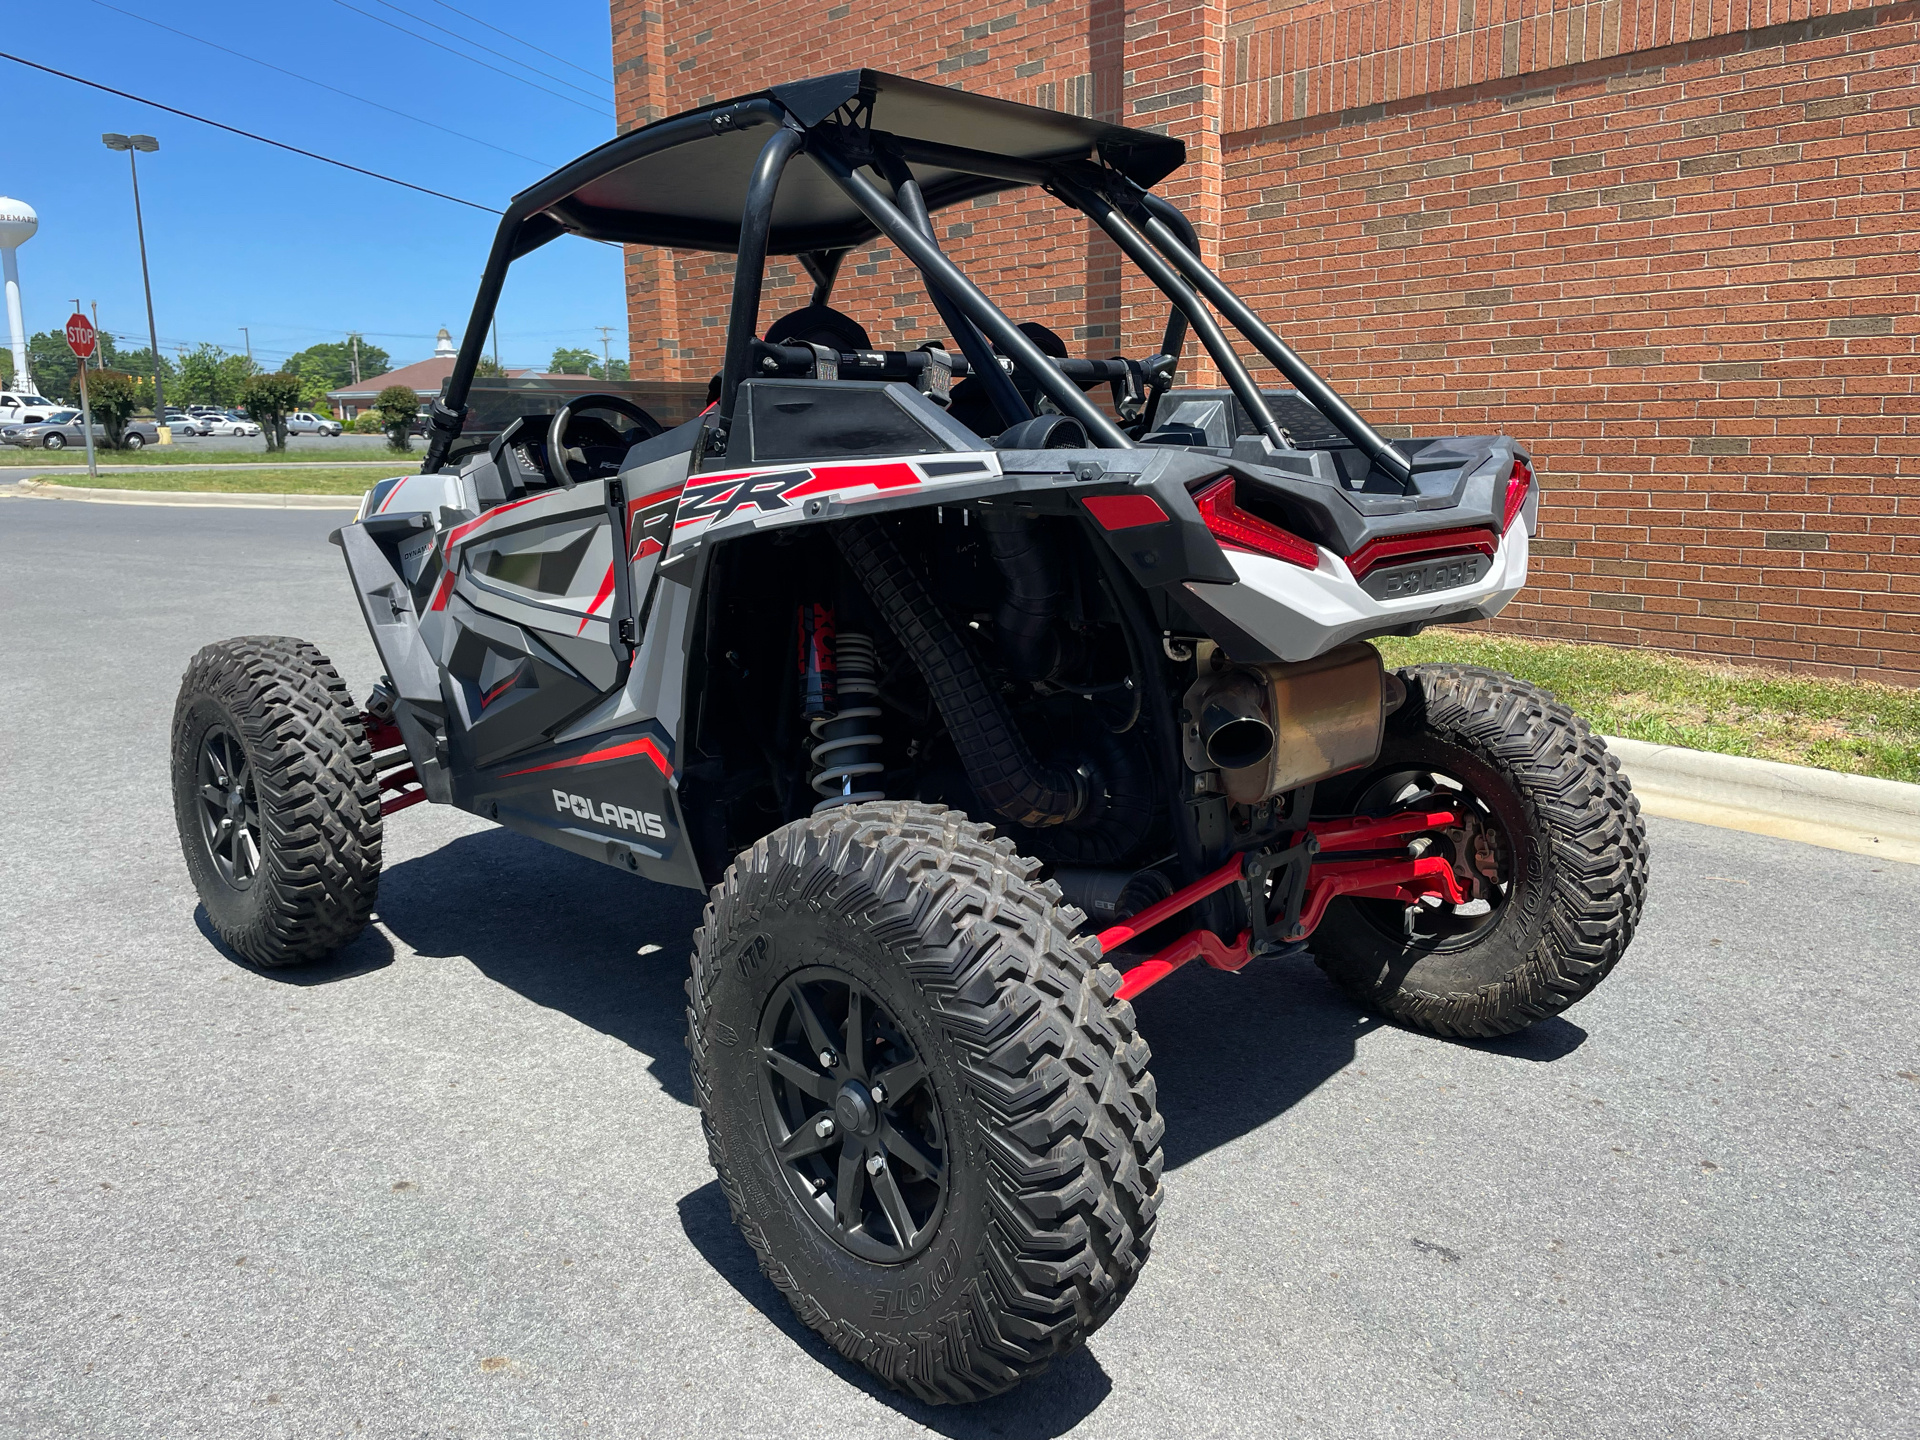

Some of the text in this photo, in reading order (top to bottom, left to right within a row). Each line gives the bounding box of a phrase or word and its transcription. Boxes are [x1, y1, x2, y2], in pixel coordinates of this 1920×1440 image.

[68, 326, 94, 344] STOP
[1383, 558, 1479, 599] POLARIS
[552, 788, 666, 839] POLARIS
